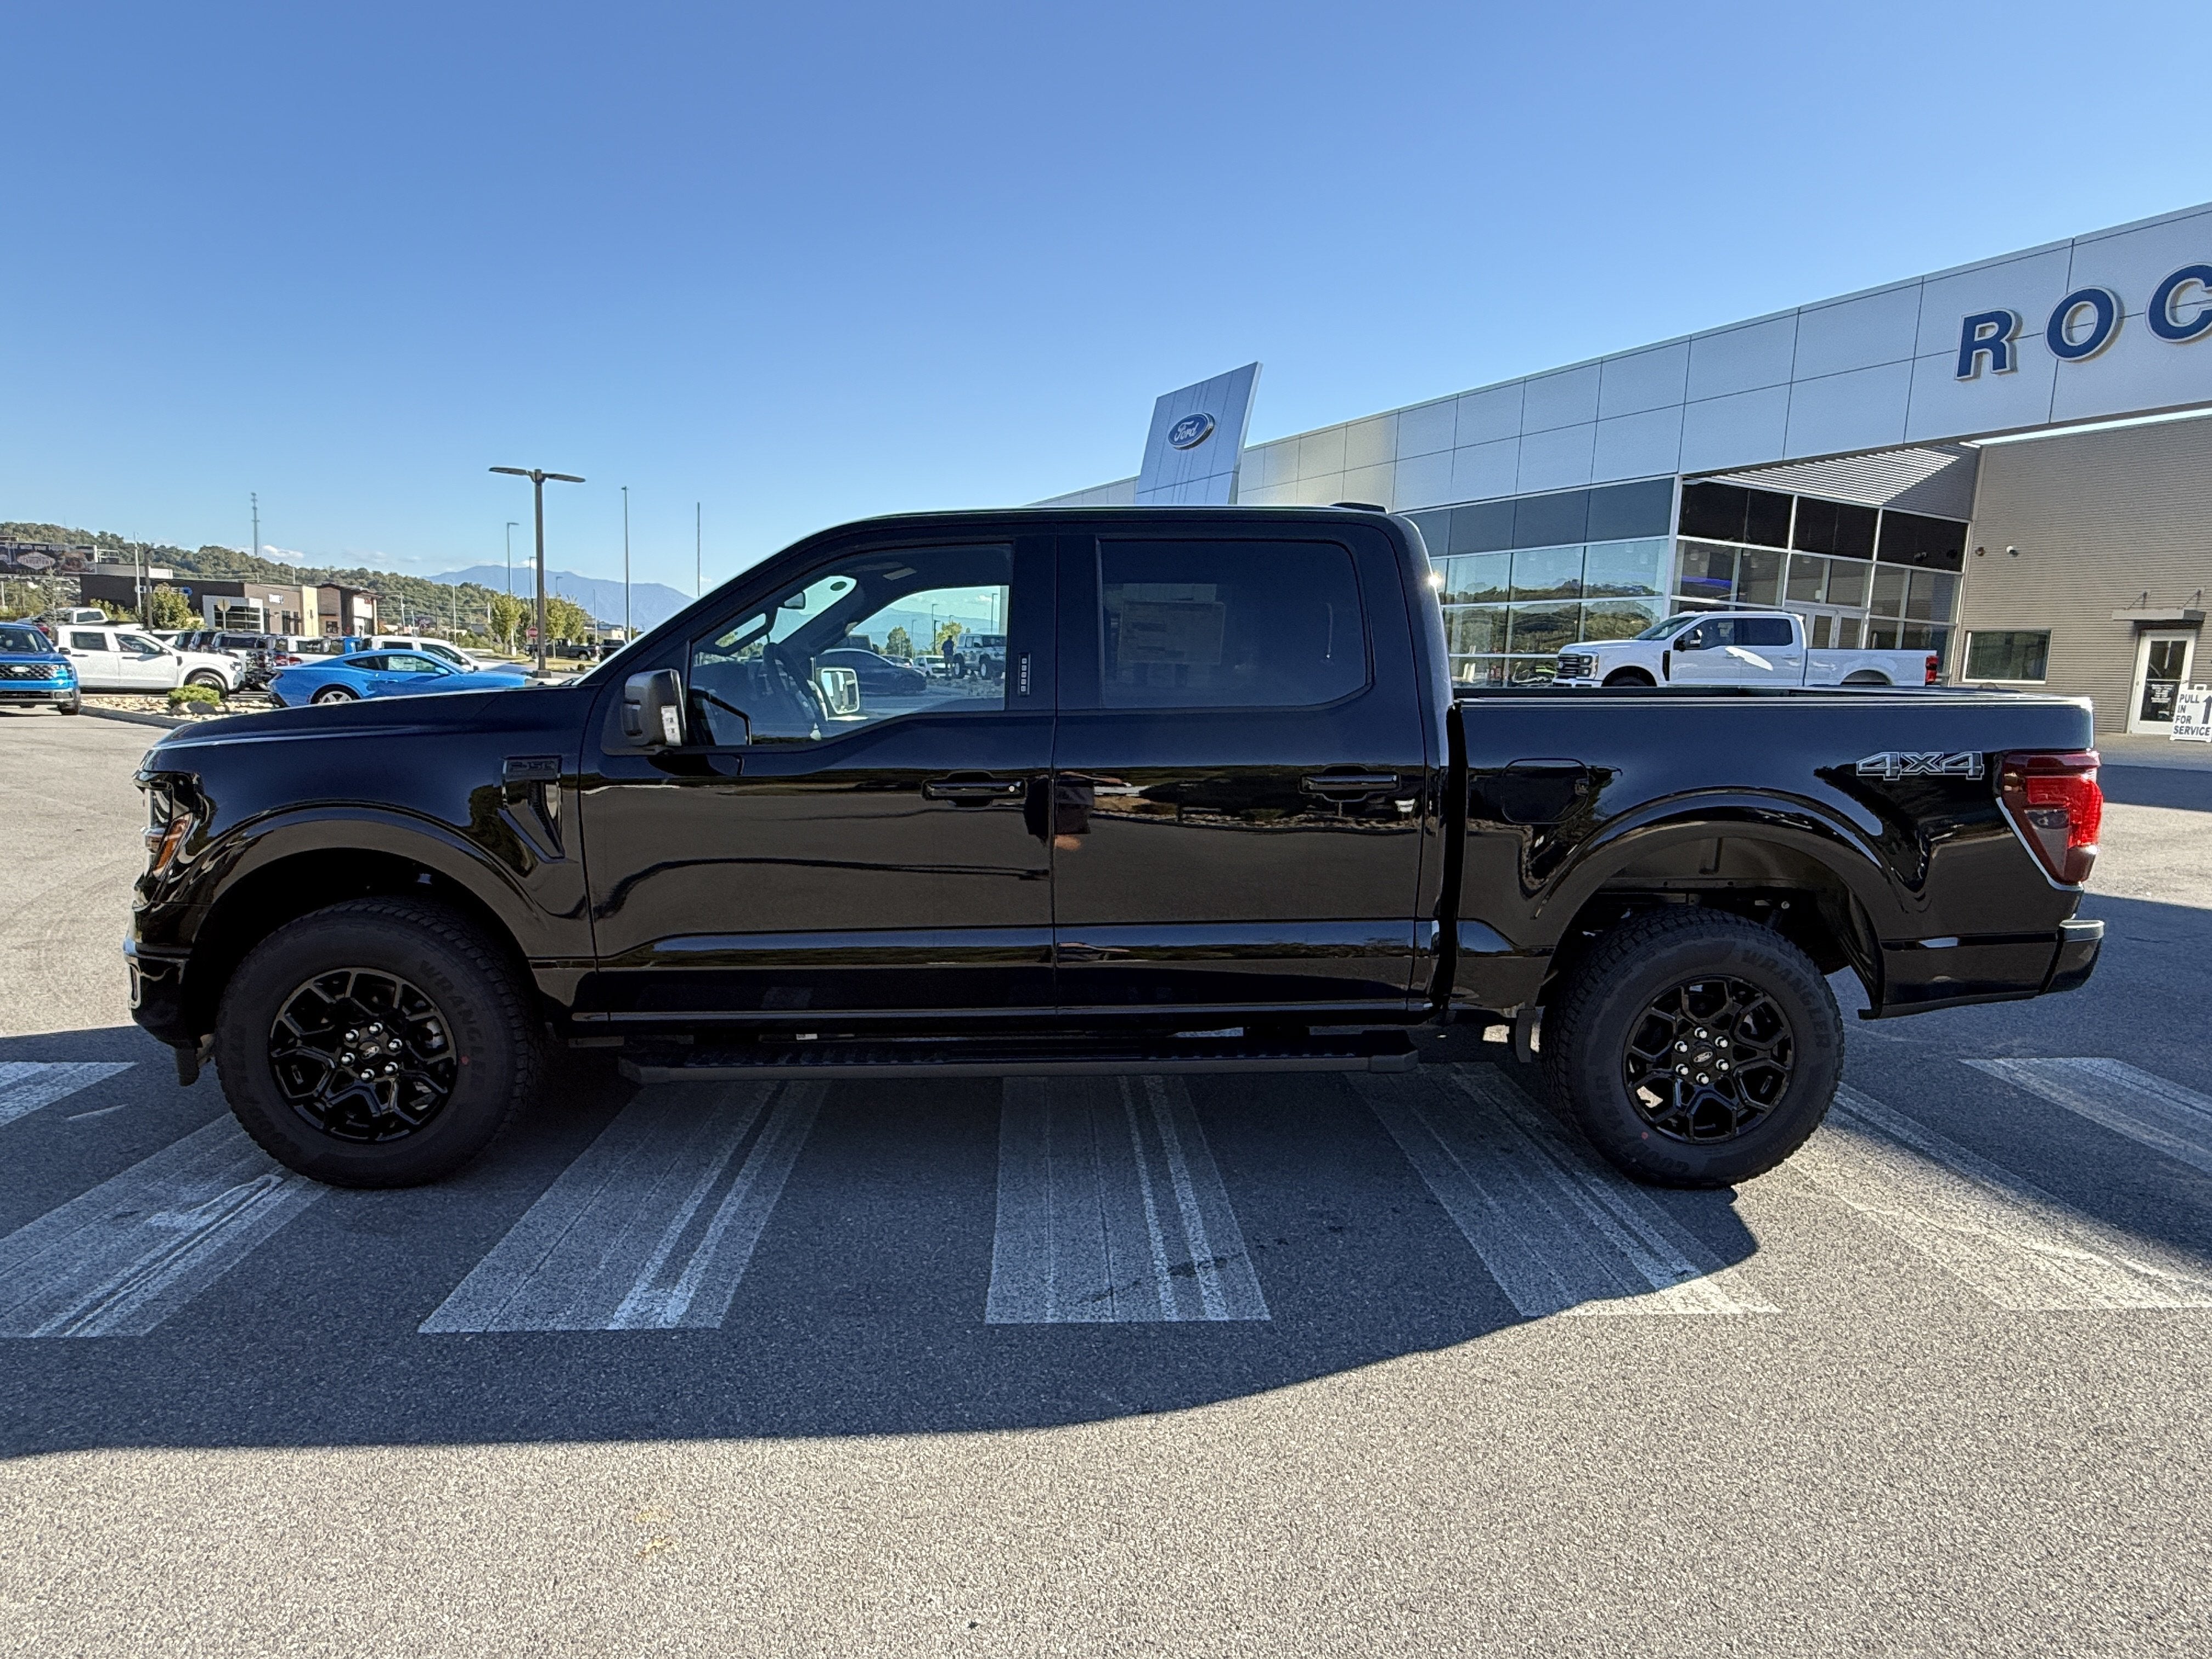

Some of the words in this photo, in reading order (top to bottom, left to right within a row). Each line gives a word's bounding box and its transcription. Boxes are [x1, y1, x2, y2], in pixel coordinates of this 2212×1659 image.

[1173, 420, 1199, 442] Ford
[2179, 694, 2199, 703] PULL
[2177, 705, 2186, 713] IN
[2175, 715, 2192, 724] FOR
[2173, 725, 2211, 736] SERVICE
